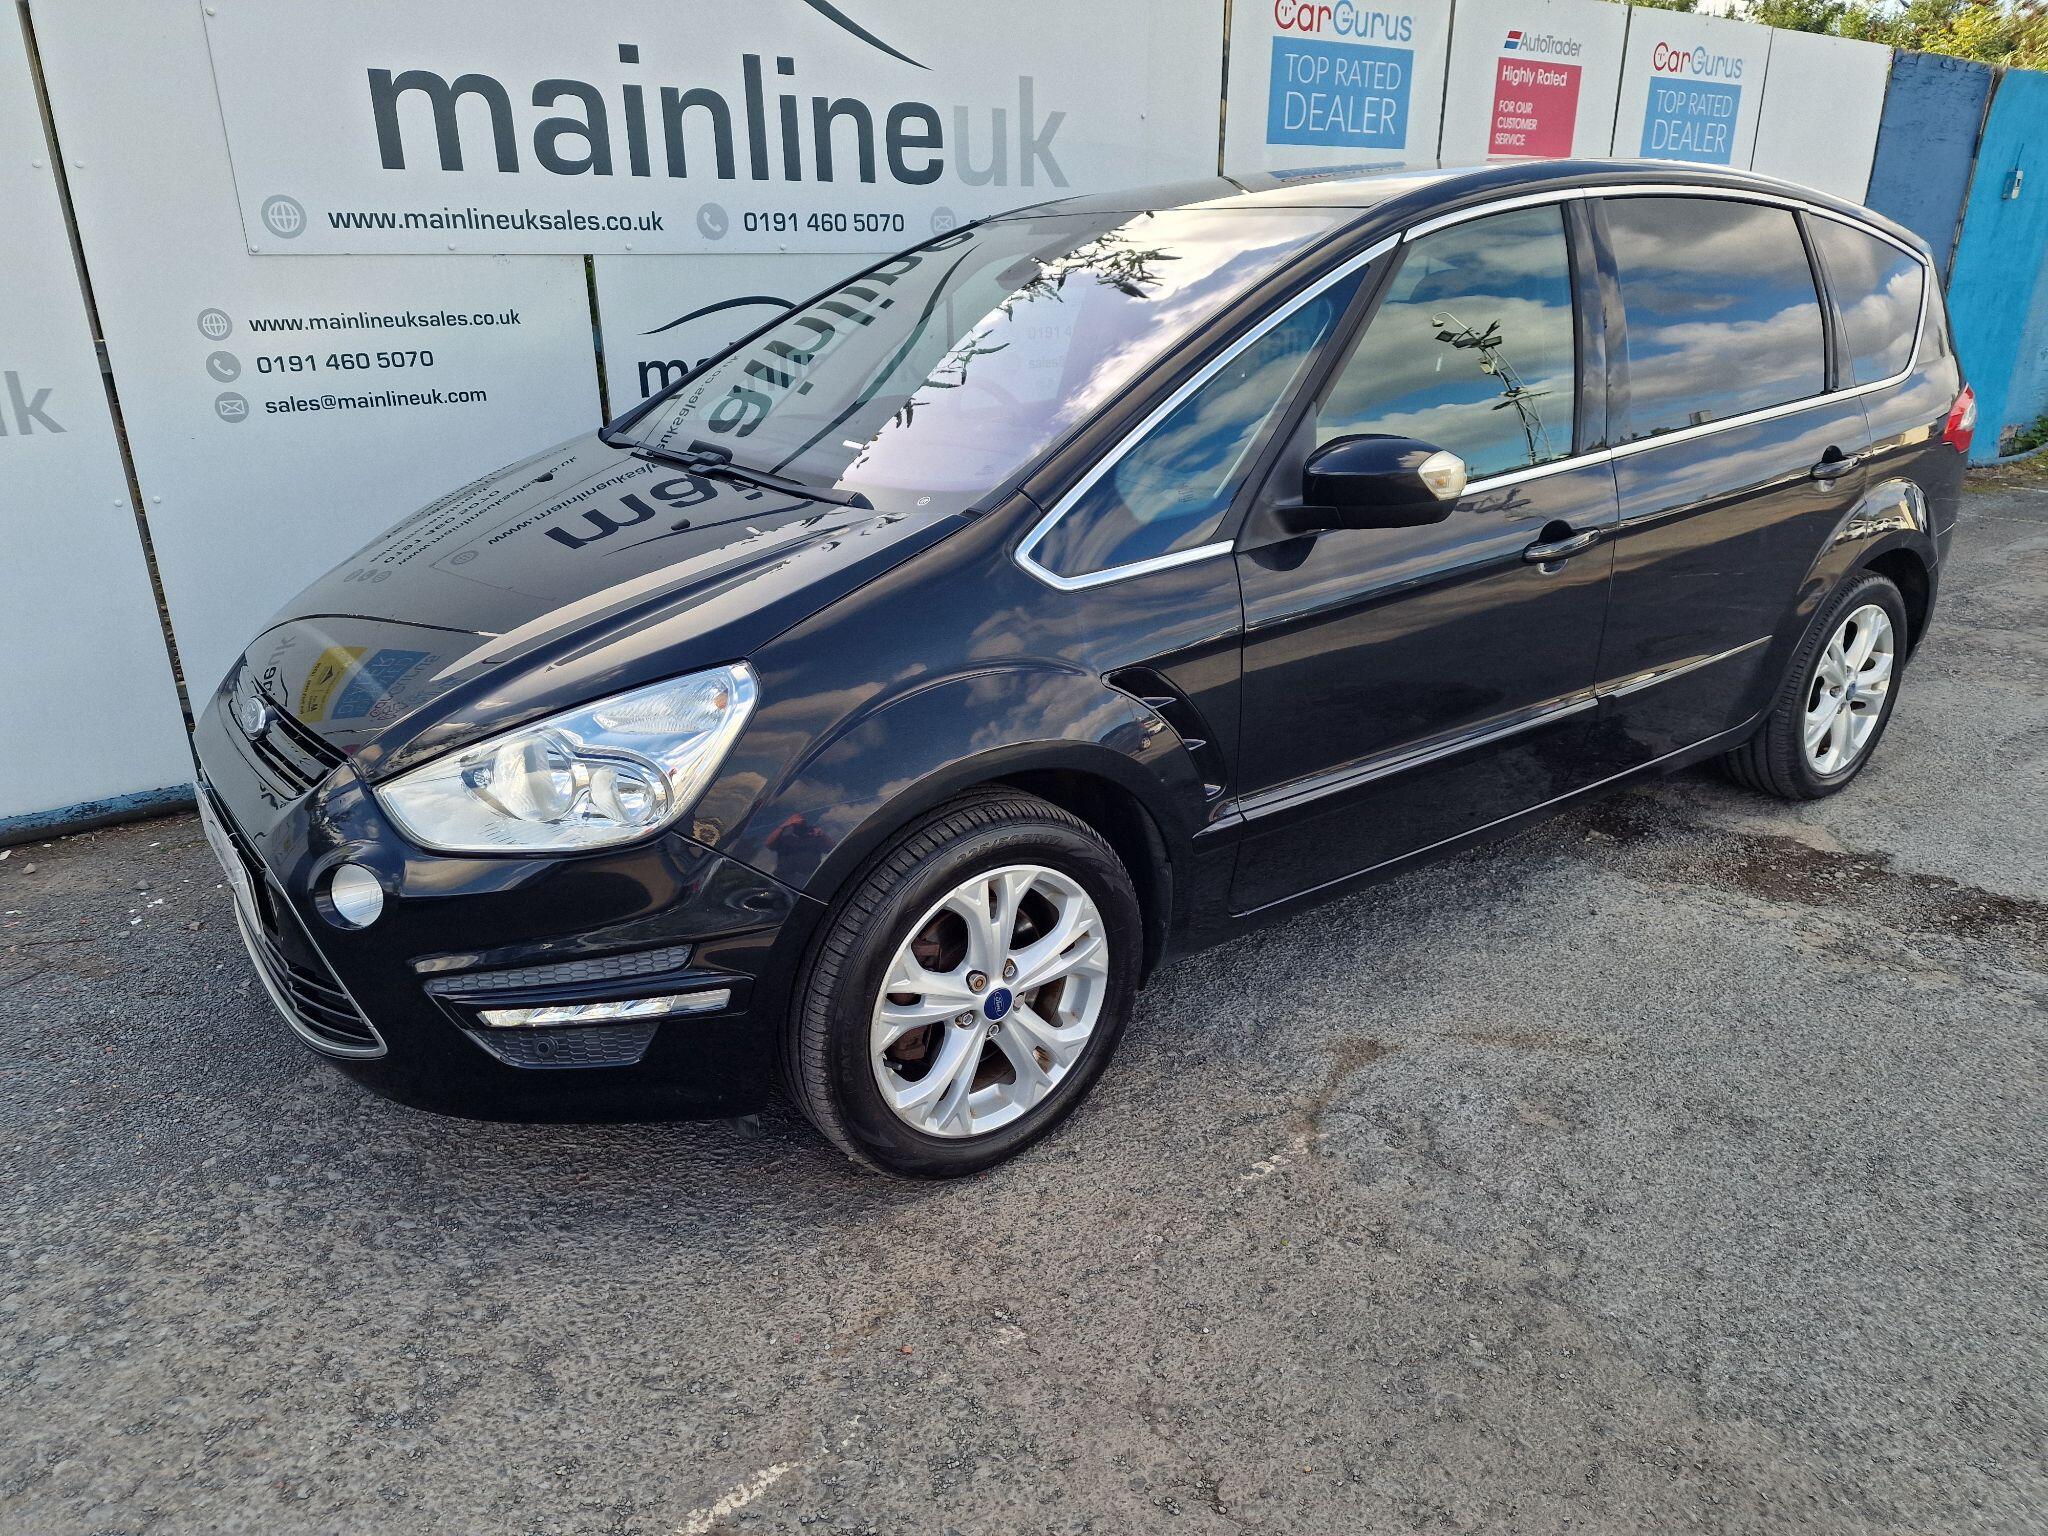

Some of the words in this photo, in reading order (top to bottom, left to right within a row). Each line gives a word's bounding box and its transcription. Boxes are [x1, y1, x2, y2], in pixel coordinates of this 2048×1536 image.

[1274, 0, 1413, 42] CarGurus
[1519, 31, 1582, 56] AutoTrader
[1285, 53, 1330, 85] TOP
[1334, 58, 1402, 90] RATED
[1653, 41, 1743, 79] CarGurus
[1502, 64, 1536, 87] Highly
[1536, 68, 1568, 87] Rated
[367, 43, 1069, 187] mainlineuk
[1284, 91, 1397, 135] DEALER
[1498, 100, 1516, 113] FOR
[1516, 101, 1534, 114] OUR
[1657, 89, 1687, 114] TOP
[1688, 92, 1733, 118] RATED
[1497, 116, 1538, 131] CUSTOMER
[1651, 119, 1728, 153] DEALER
[1495, 132, 1526, 146] SERVICE
[328, 207, 665, 232] www.mainlineuksales.co.uk
[743, 211, 799, 232] 0191
[806, 212, 848, 232] 460
[853, 213, 905, 232] 5070
[249, 308, 522, 332] www.mainlineuksales.co.uk
[256, 353, 317, 374] 0191
[325, 352, 371, 371] 460
[376, 350, 435, 369] 5070
[0, 370, 68, 437] k
[265, 388, 488, 414] sales@mainlineuk.com
